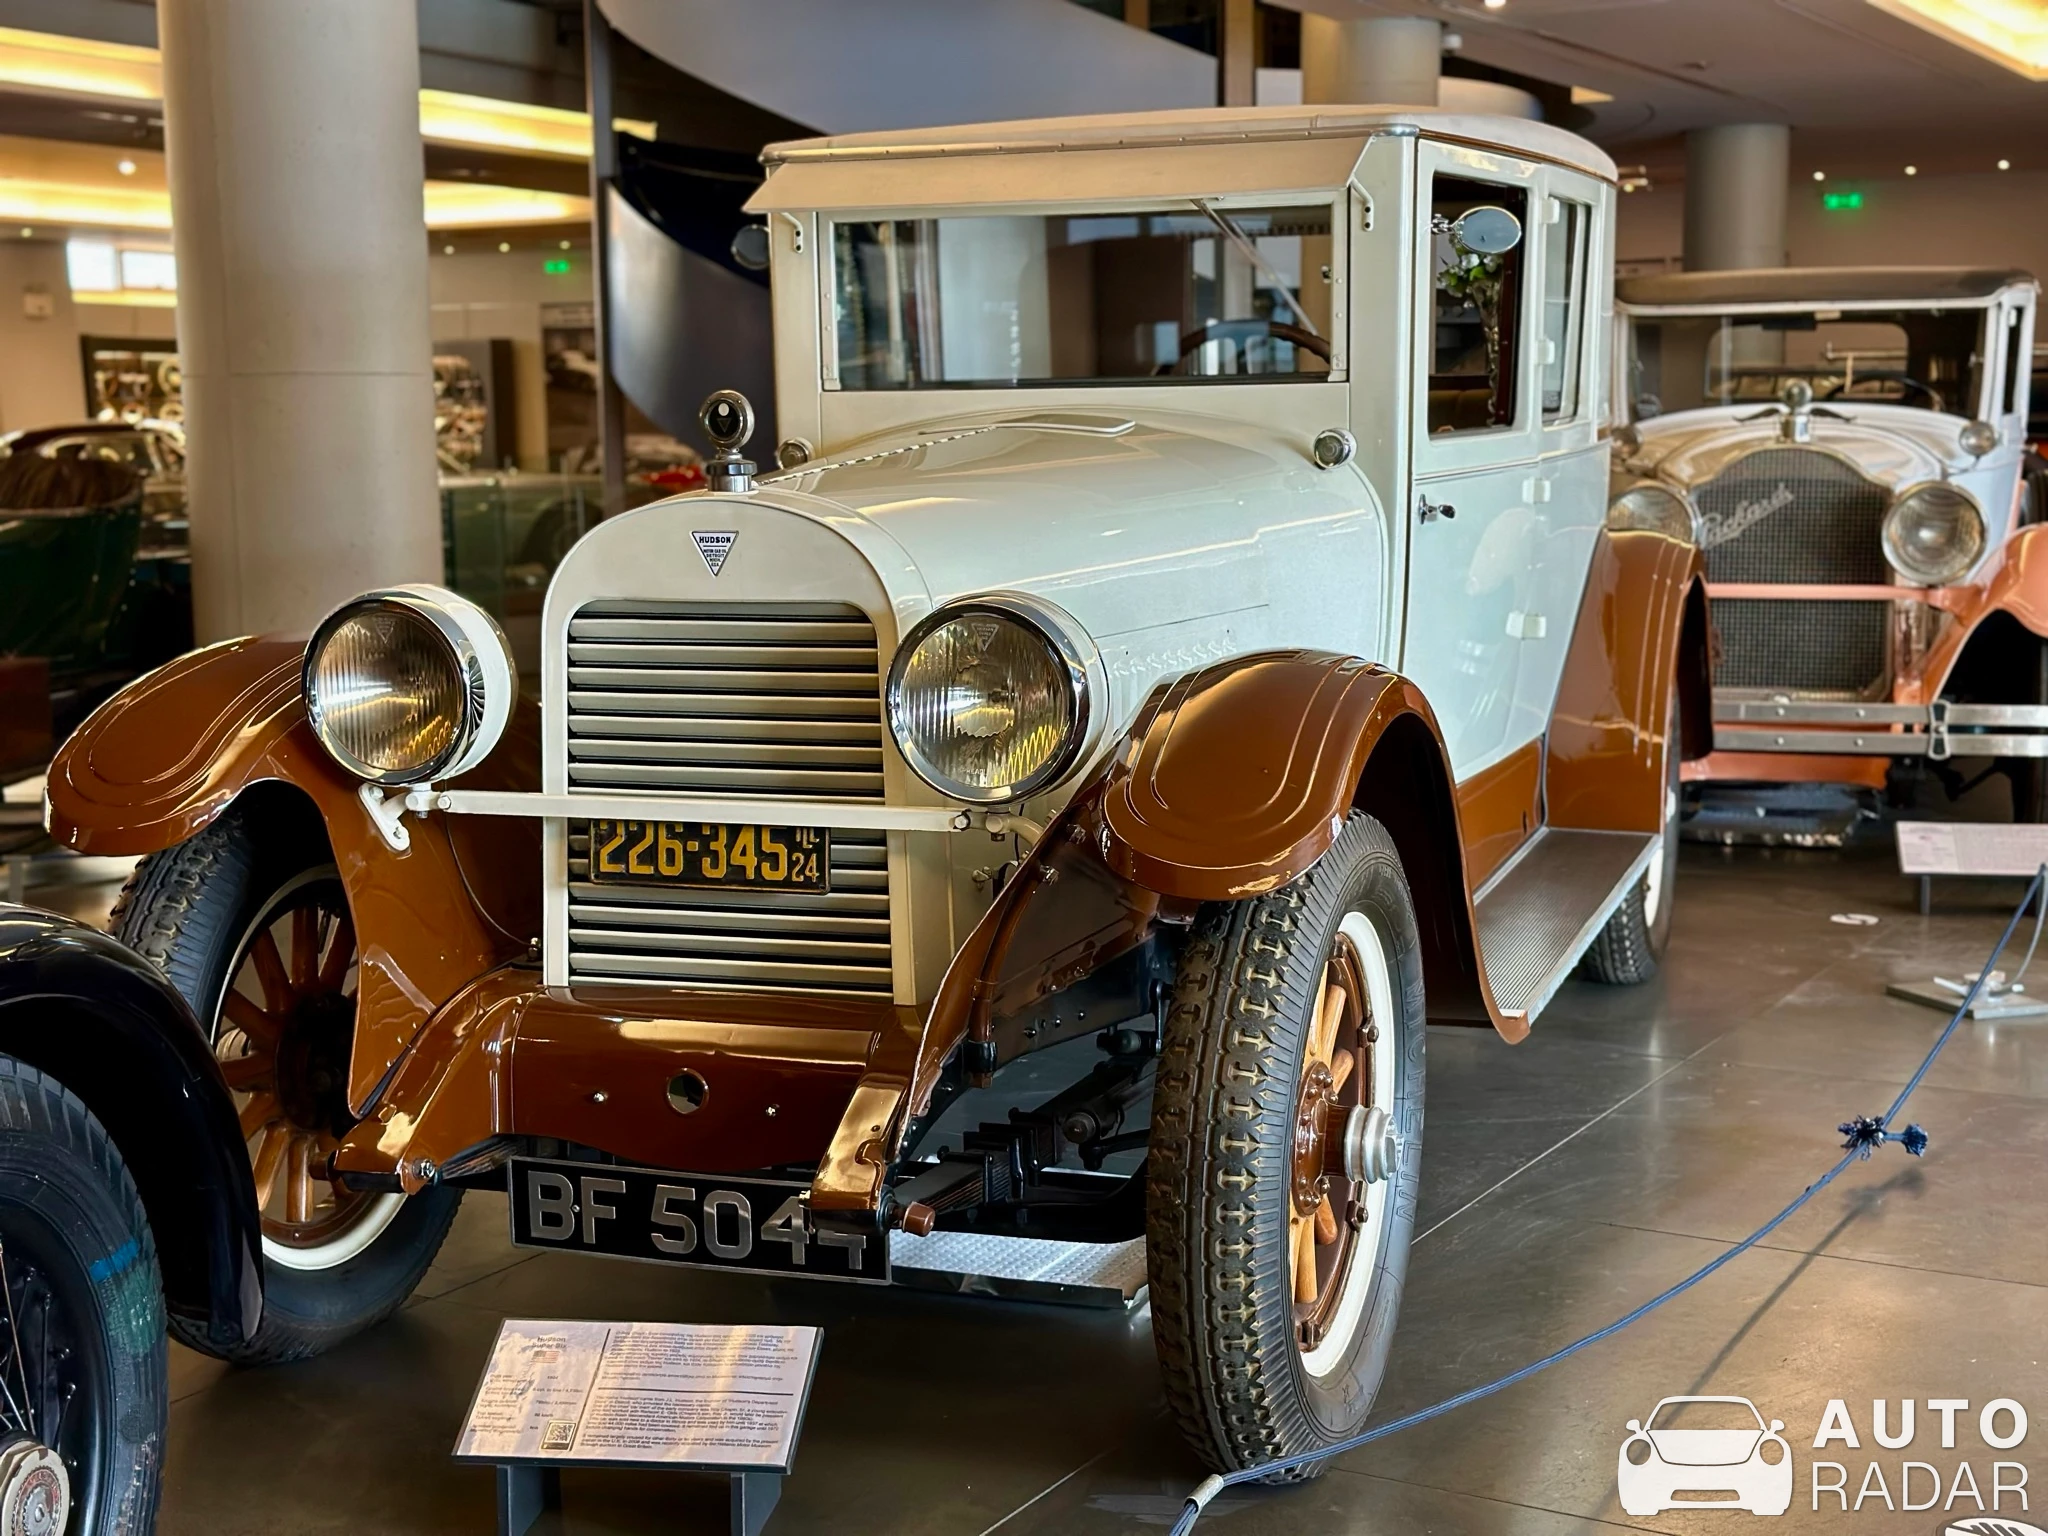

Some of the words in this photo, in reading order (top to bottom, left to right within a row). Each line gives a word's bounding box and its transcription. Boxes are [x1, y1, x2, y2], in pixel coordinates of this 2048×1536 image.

[699, 536, 731, 544] HUDSON
[599, 820, 788, 882] 226-345
[791, 852, 820, 883] 24
[1396, 978, 1426, 1225] MICHELIN
[528, 1170, 626, 1245] BF
